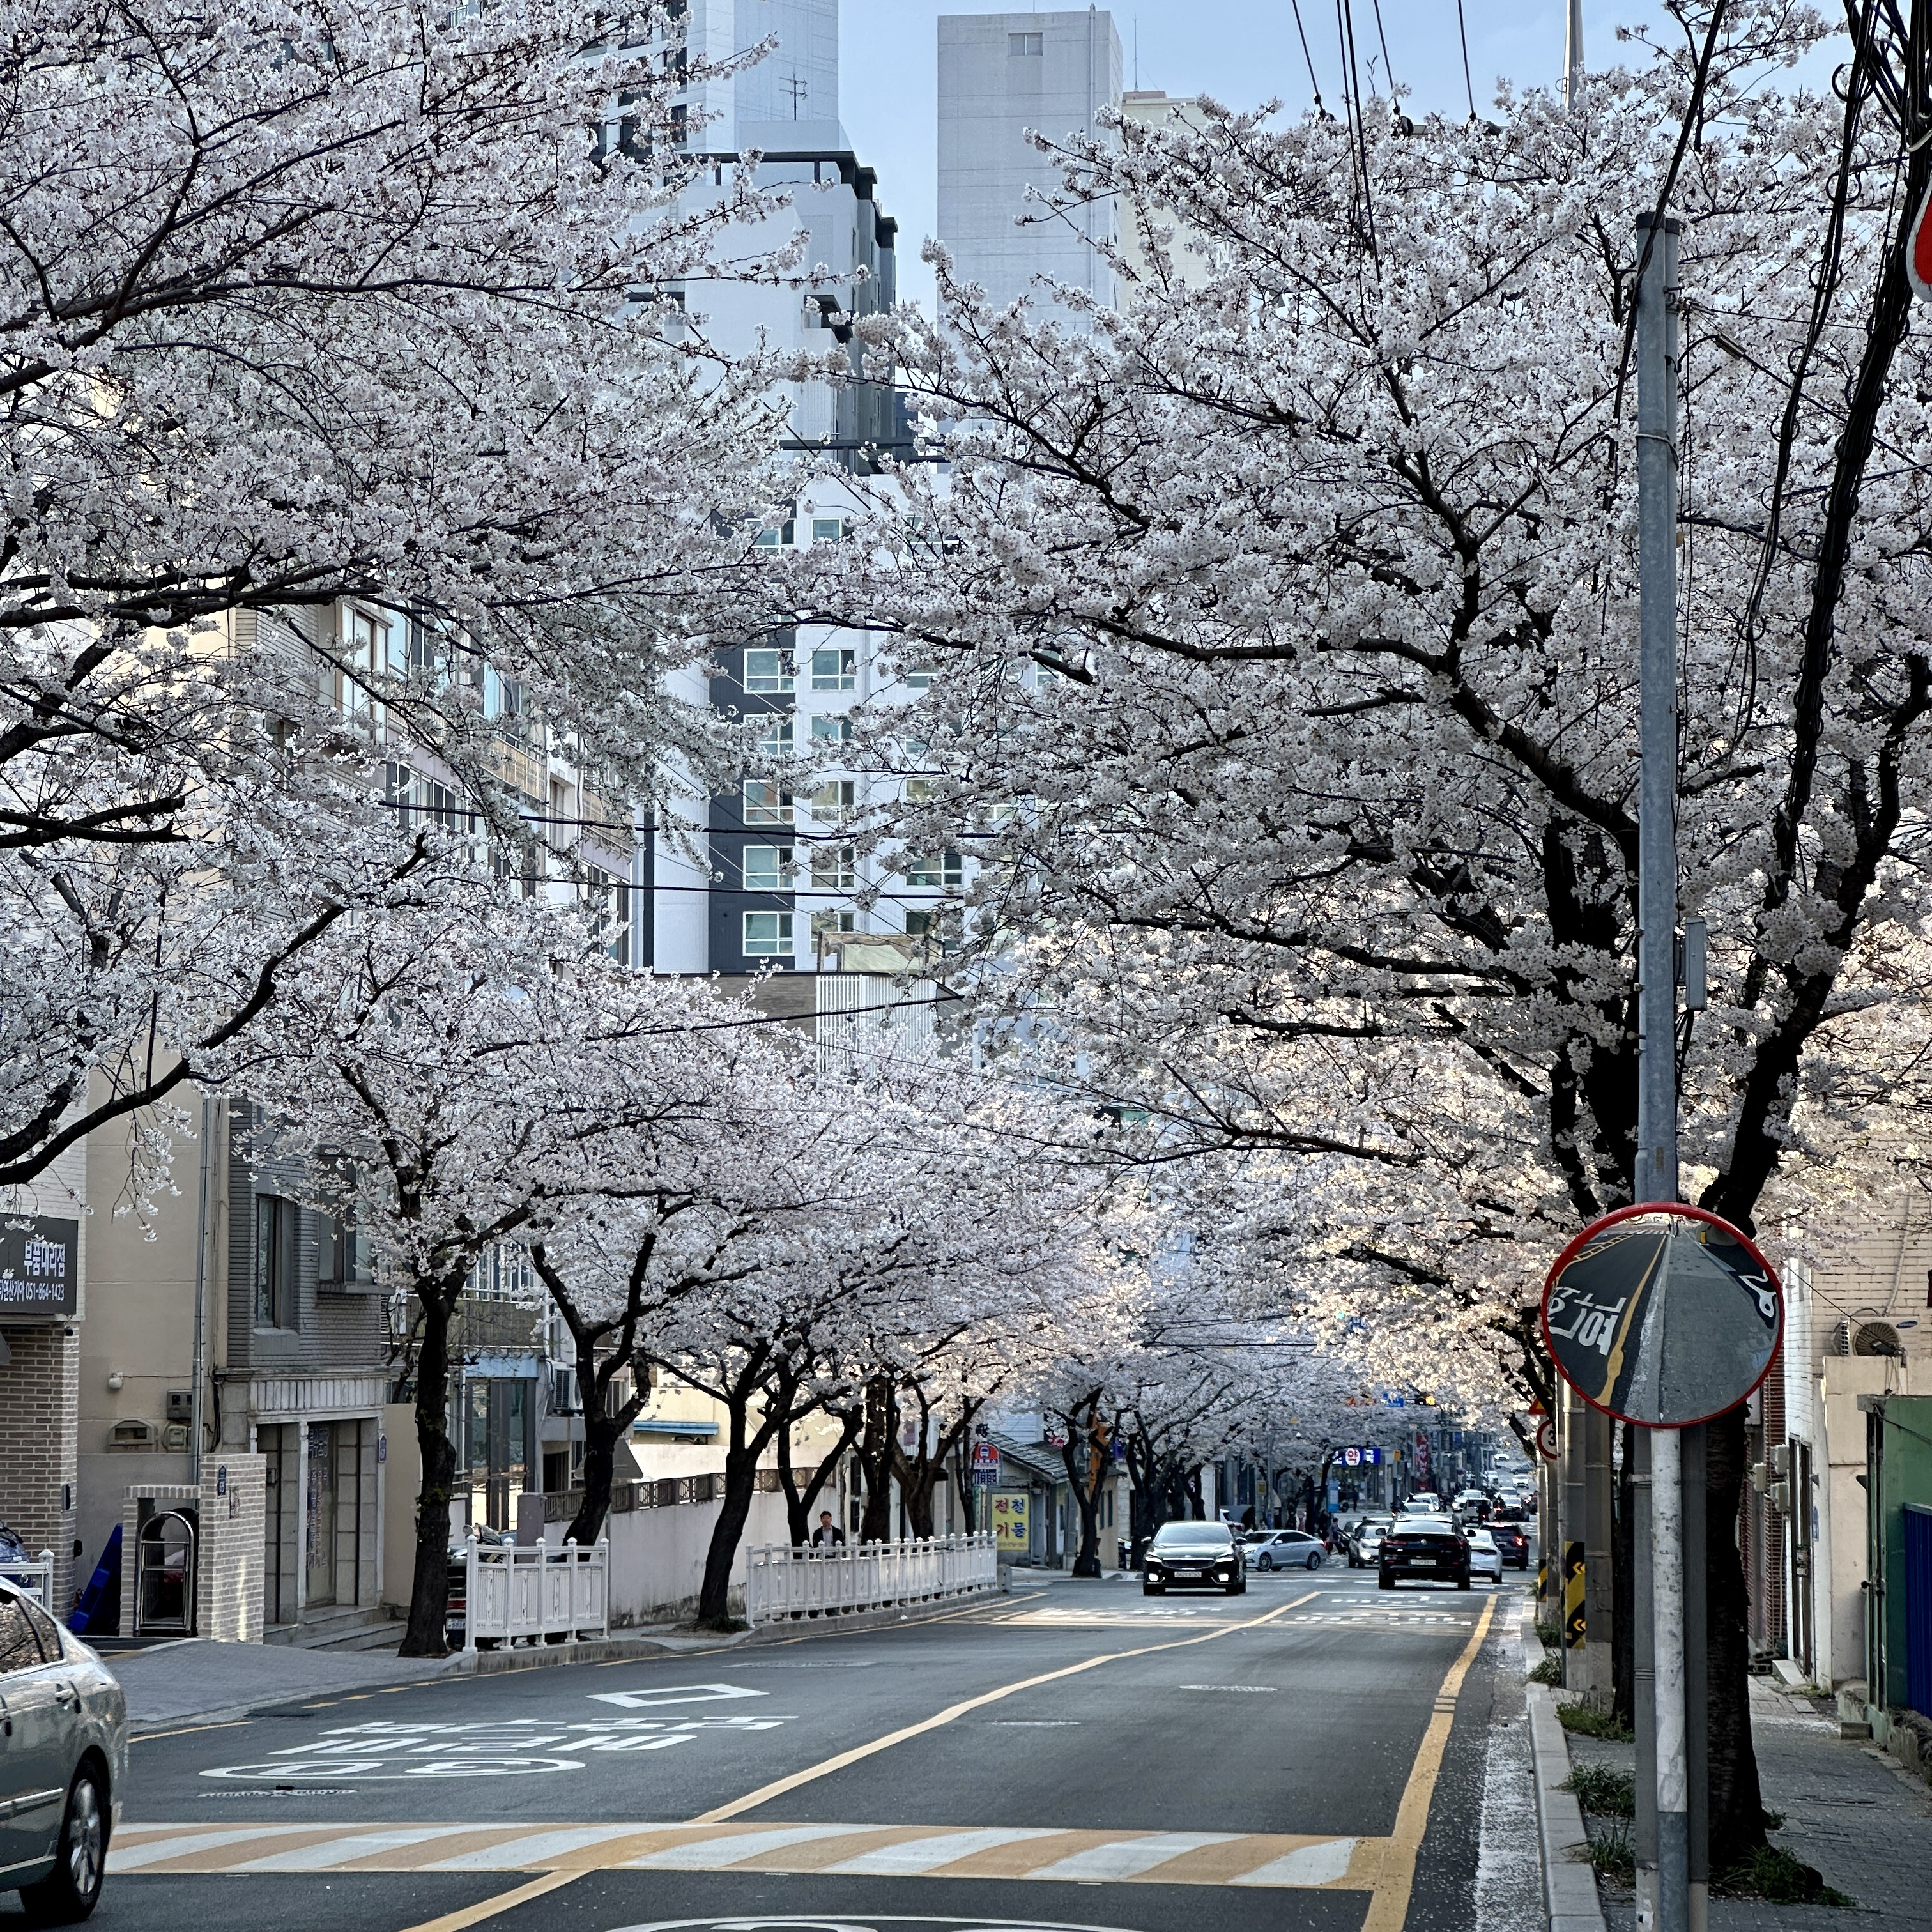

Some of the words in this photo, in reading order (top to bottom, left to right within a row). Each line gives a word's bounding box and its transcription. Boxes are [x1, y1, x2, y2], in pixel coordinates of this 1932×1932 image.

[24, 1241, 65, 1277] 부품대리점
[26, 1282, 64, 1301] 051-864-1423
[1547, 1430, 1557, 1446] 3
[318, 1715, 799, 1736] 보호구역
[266, 1735, 698, 1755] 어린이
[257, 1761, 532, 1776] 30
